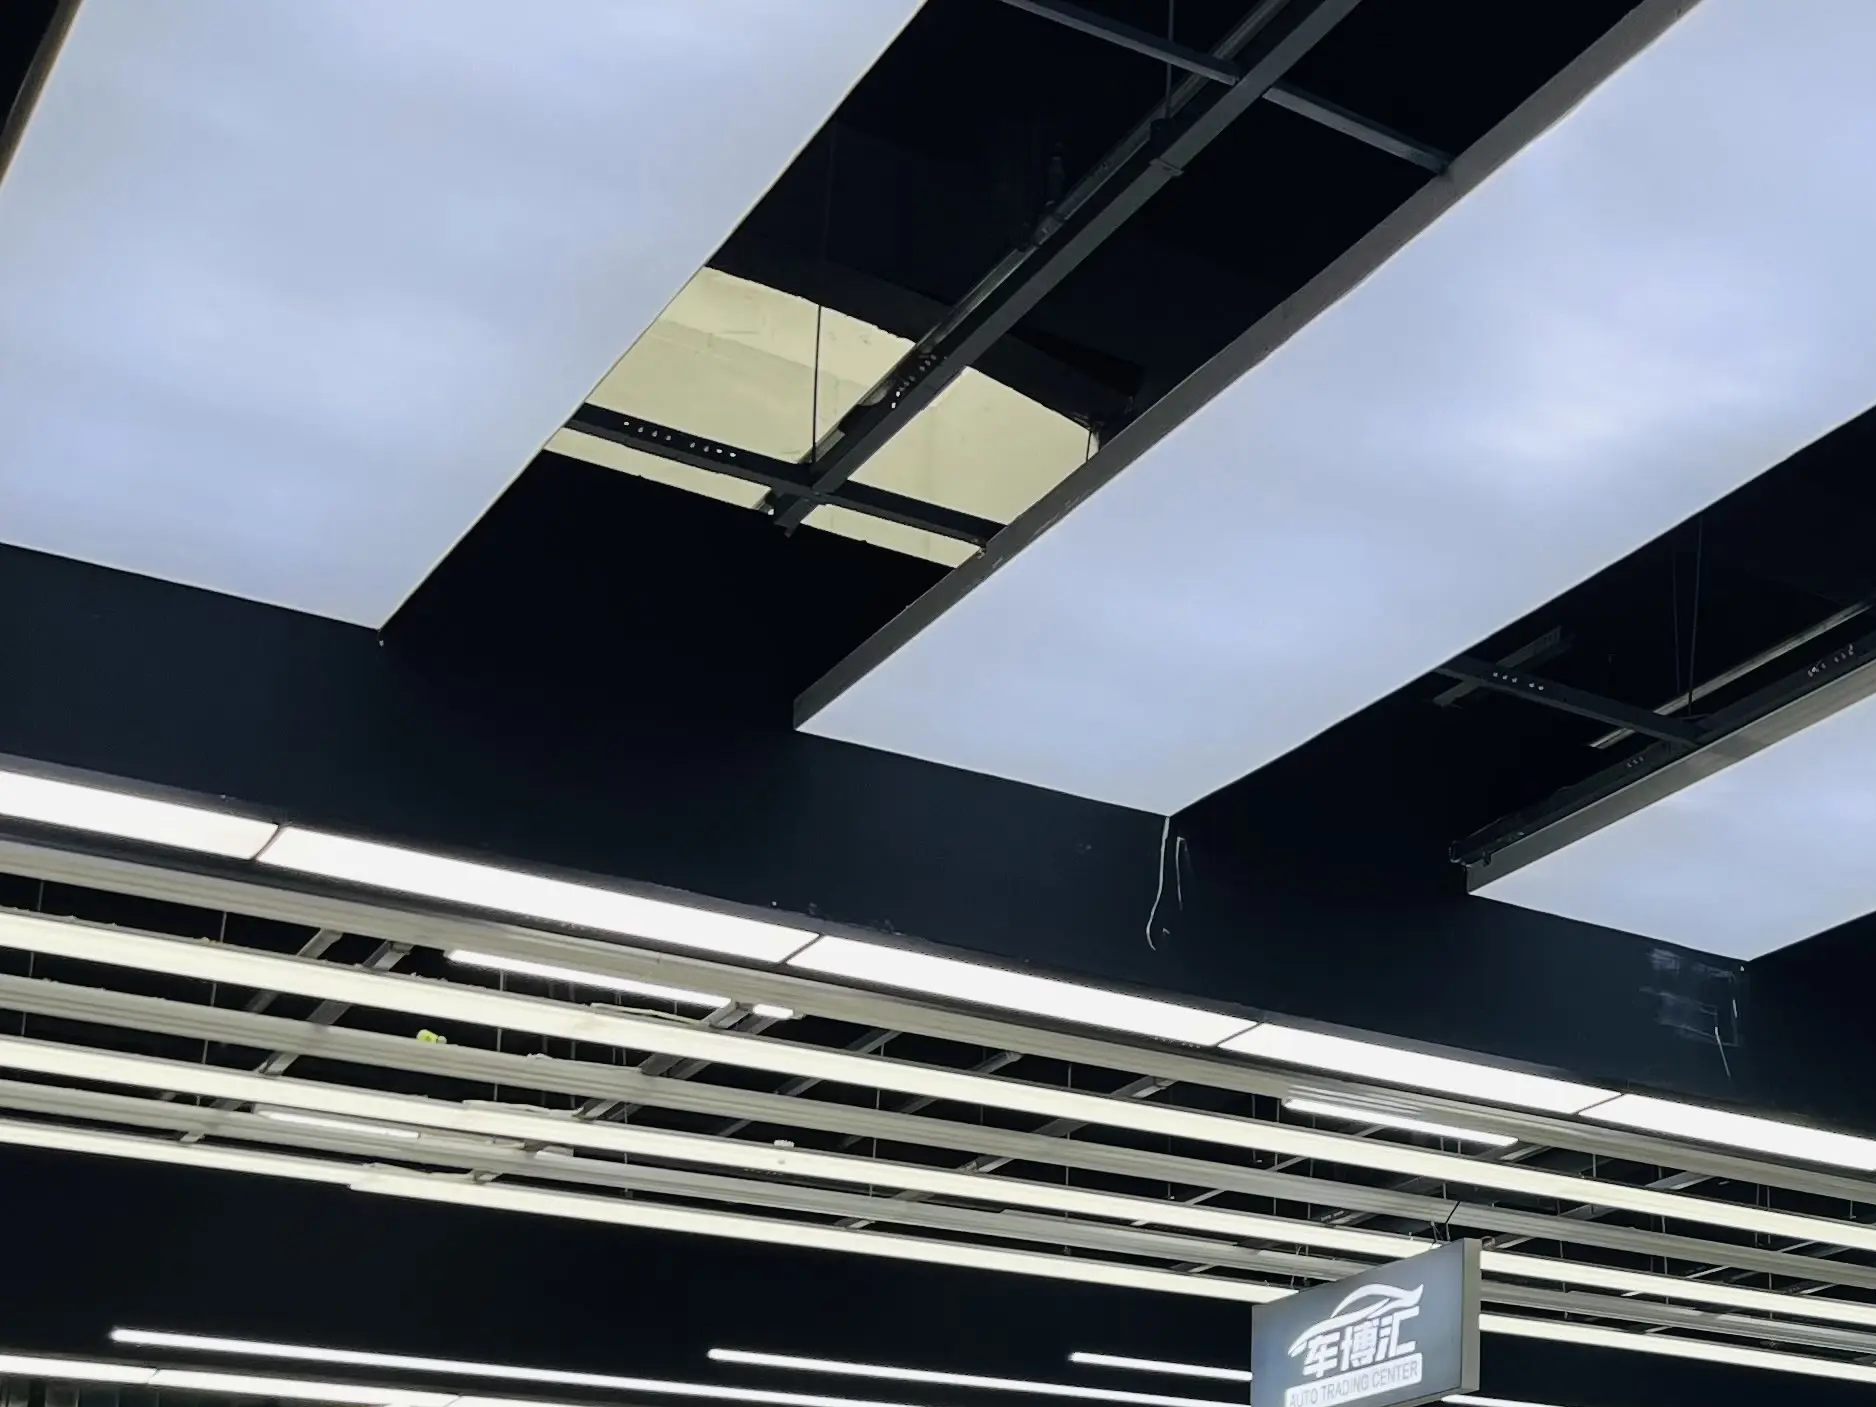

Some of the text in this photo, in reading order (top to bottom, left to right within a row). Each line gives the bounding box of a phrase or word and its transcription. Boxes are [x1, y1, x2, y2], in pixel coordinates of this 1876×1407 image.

[1303, 1306, 1419, 1378] 车博汇
[1289, 1361, 1418, 1407] AUTO TRADING CENTER
